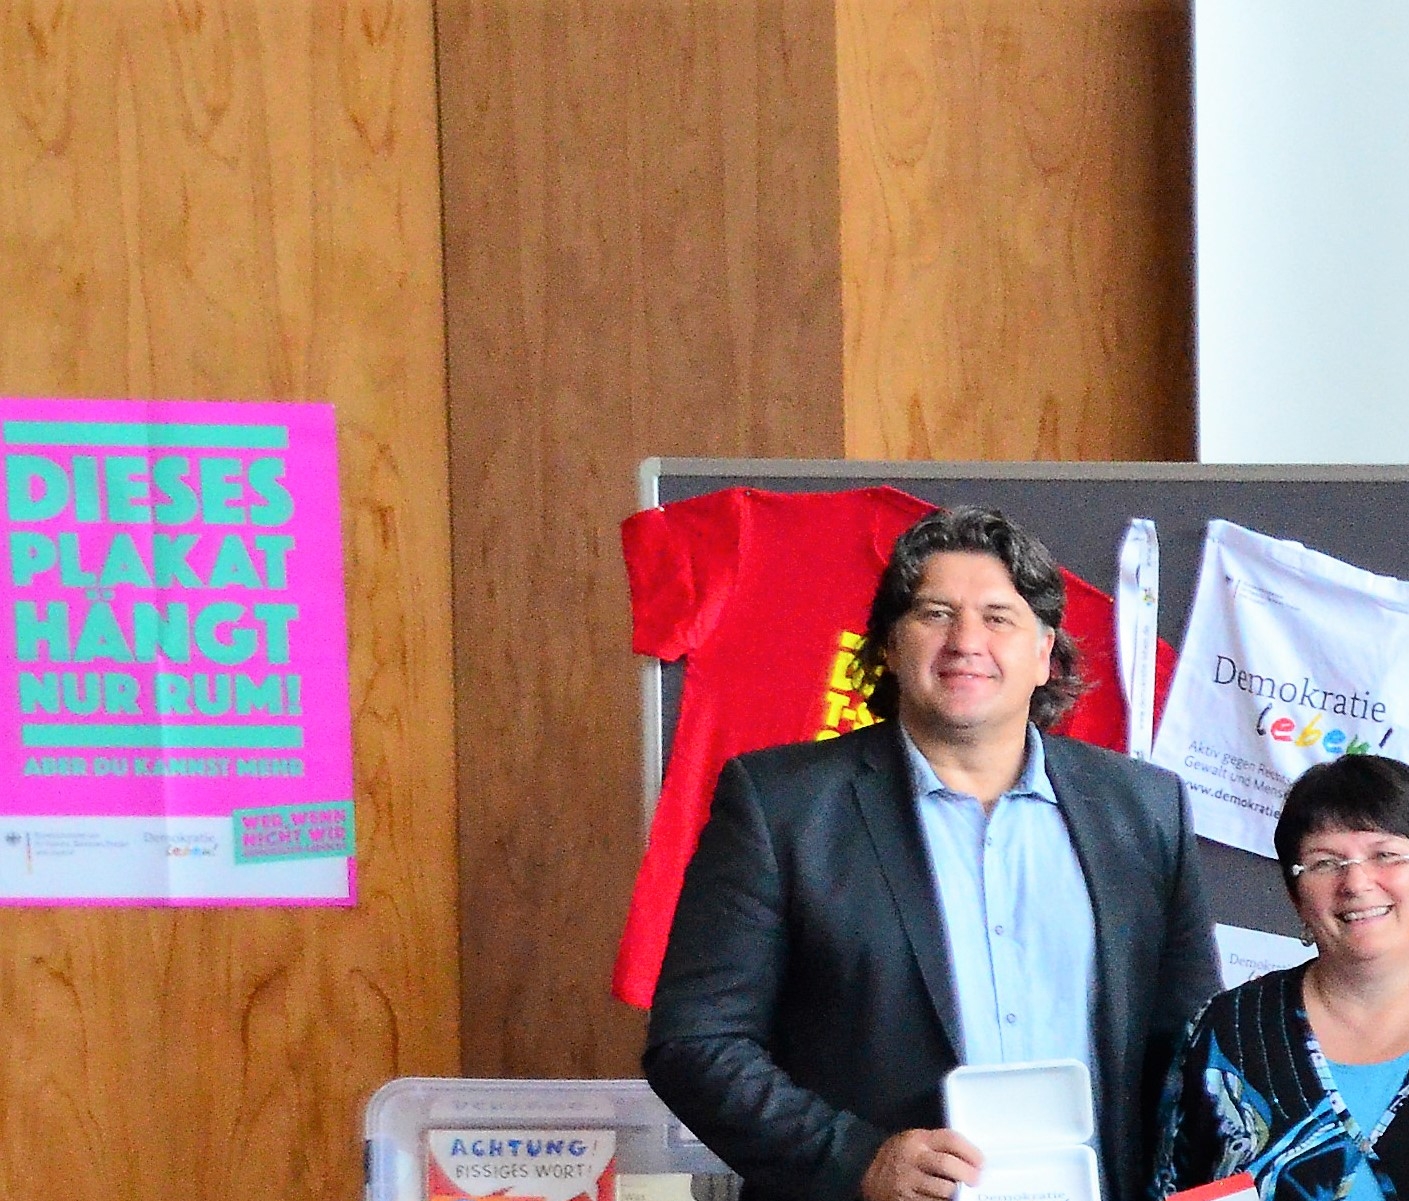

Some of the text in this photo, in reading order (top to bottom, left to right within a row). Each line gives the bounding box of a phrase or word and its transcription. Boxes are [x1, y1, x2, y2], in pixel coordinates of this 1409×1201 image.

[6, 455, 295, 526] DIESES
[9, 532, 295, 590] PLAKAT
[15, 589, 298, 665] HÄNGT
[18, 672, 302, 716] NUR RUM!
[1213, 655, 1386, 723] Demokratie
[1184, 756, 1228, 779] Gewalt
[451, 1138, 598, 1157] ACHTUNG!
[456, 1163, 593, 1180] BISSIGES WORT!
